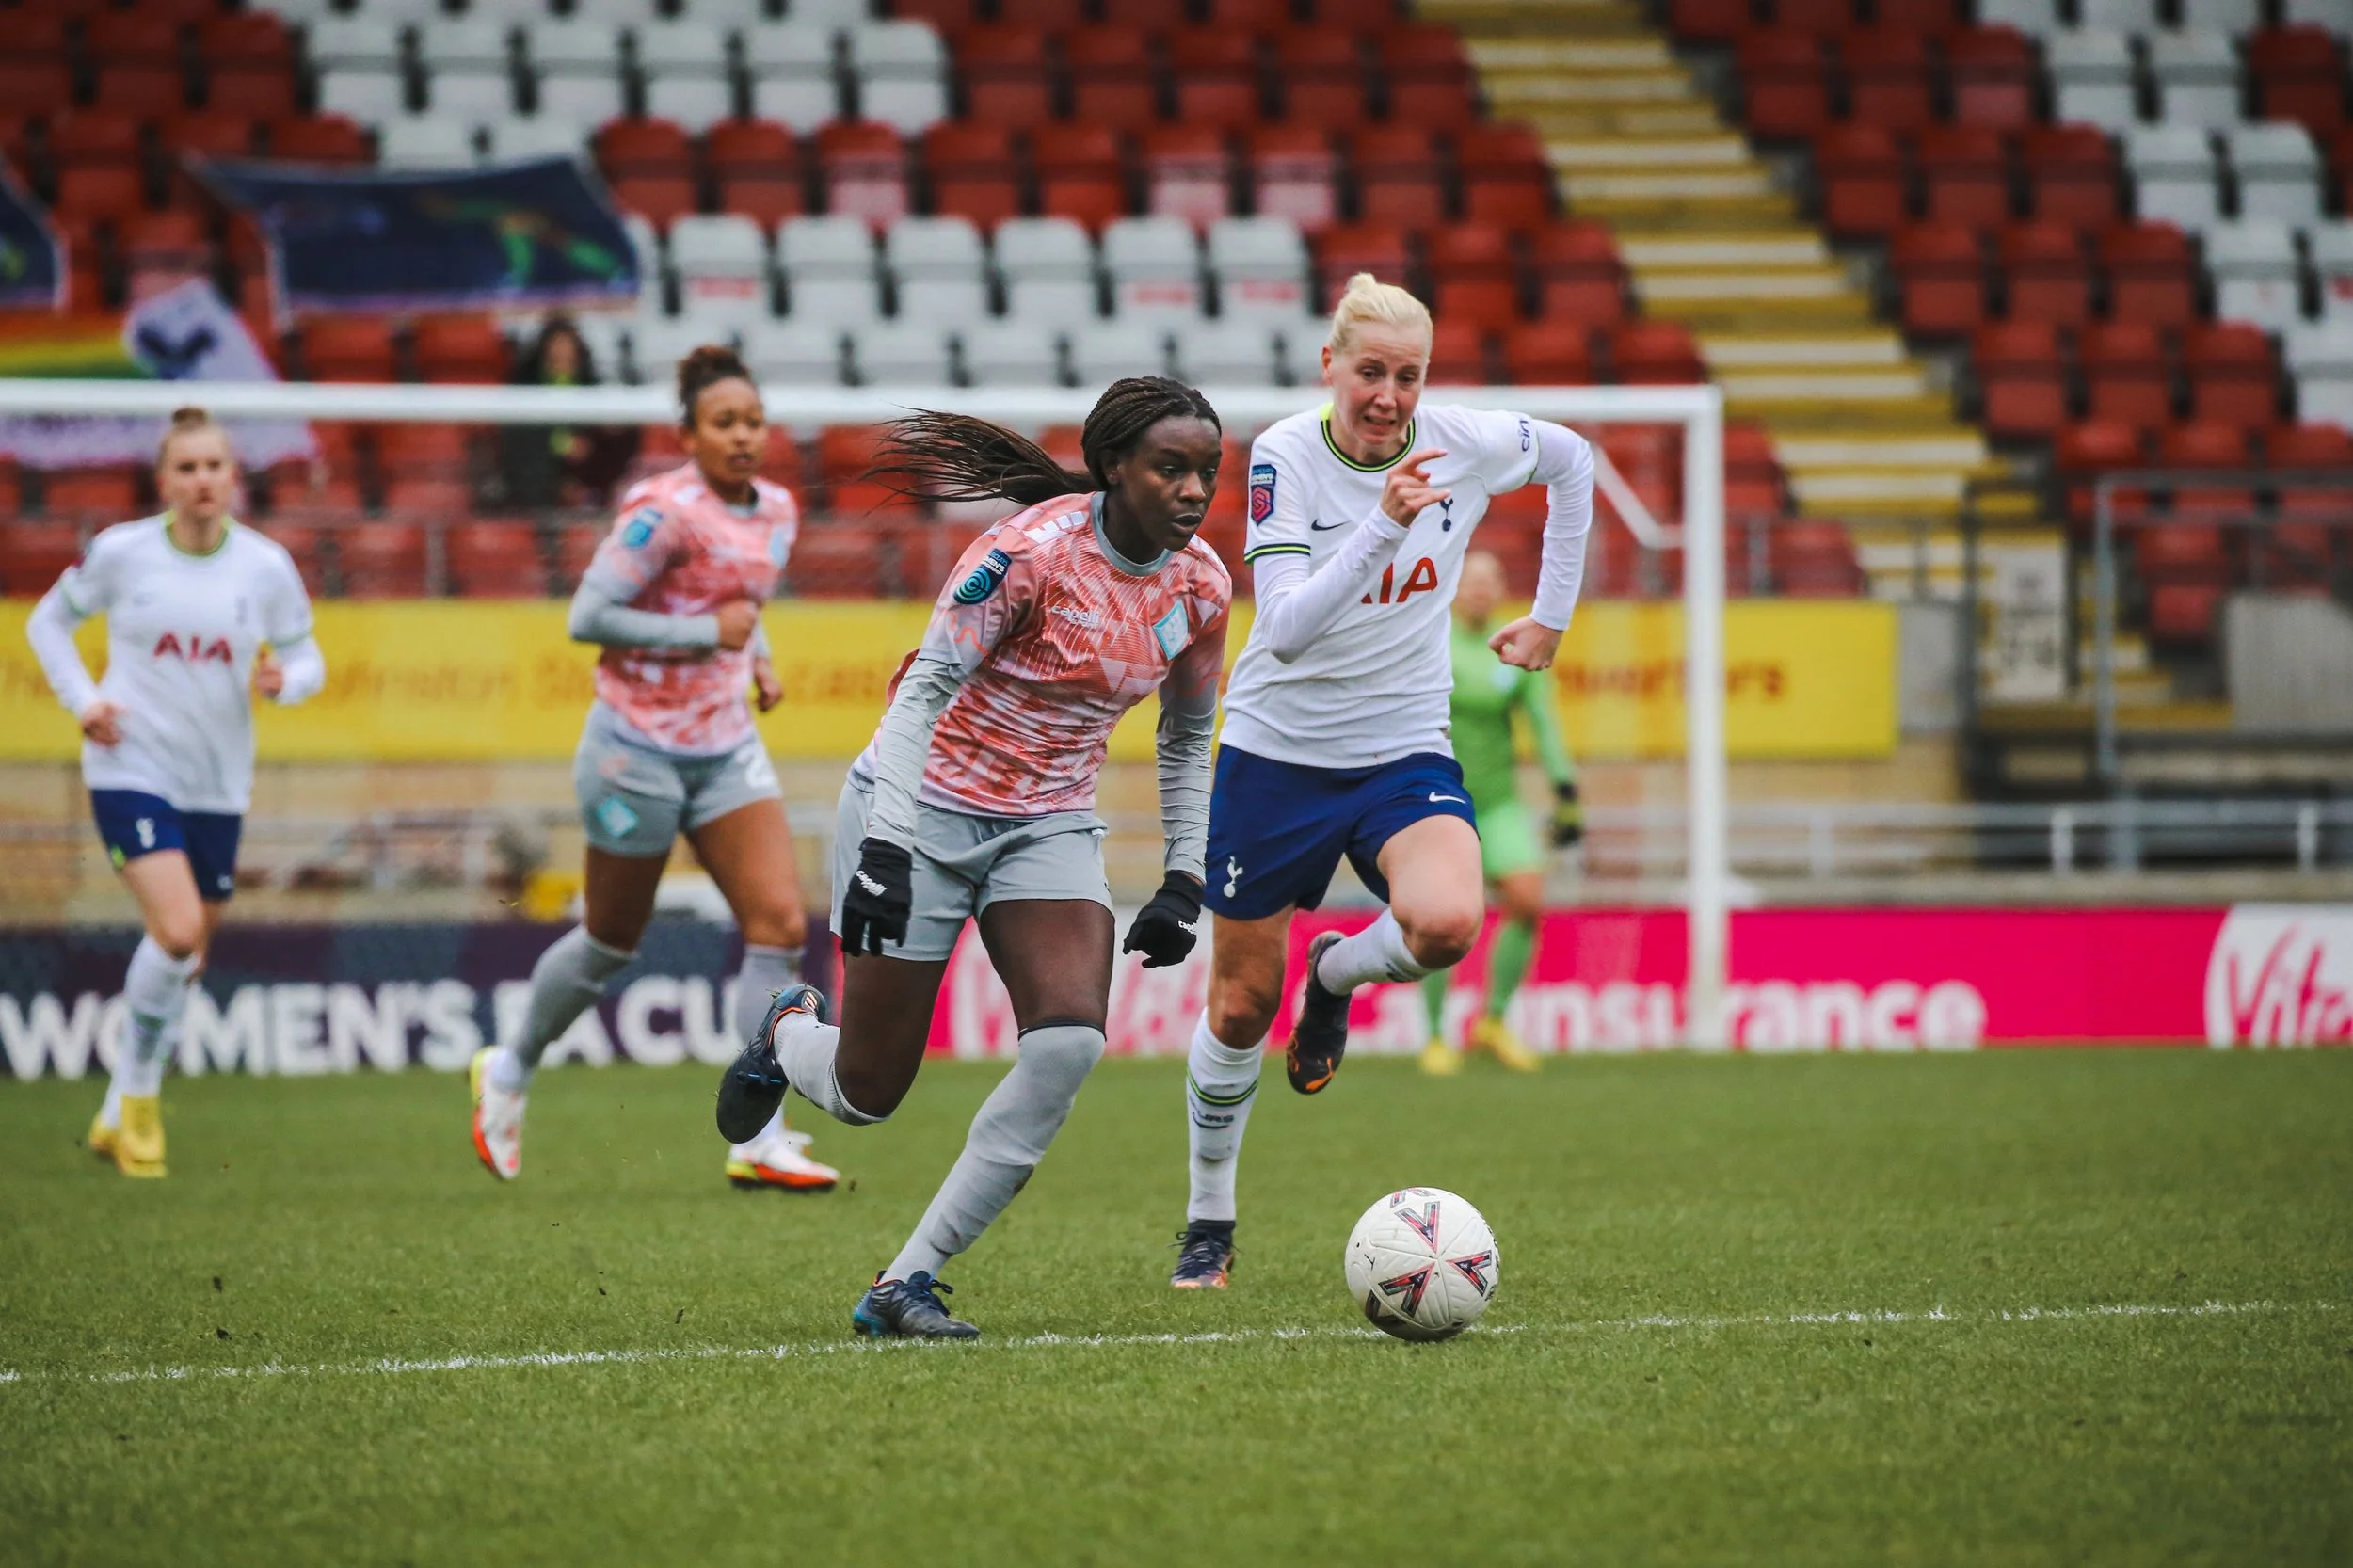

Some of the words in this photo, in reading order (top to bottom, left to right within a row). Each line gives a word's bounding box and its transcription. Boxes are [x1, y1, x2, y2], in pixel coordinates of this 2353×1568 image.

[1360, 557, 1438, 604] IA
[153, 632, 233, 666] AIA
[617, 974, 743, 1066] CU
